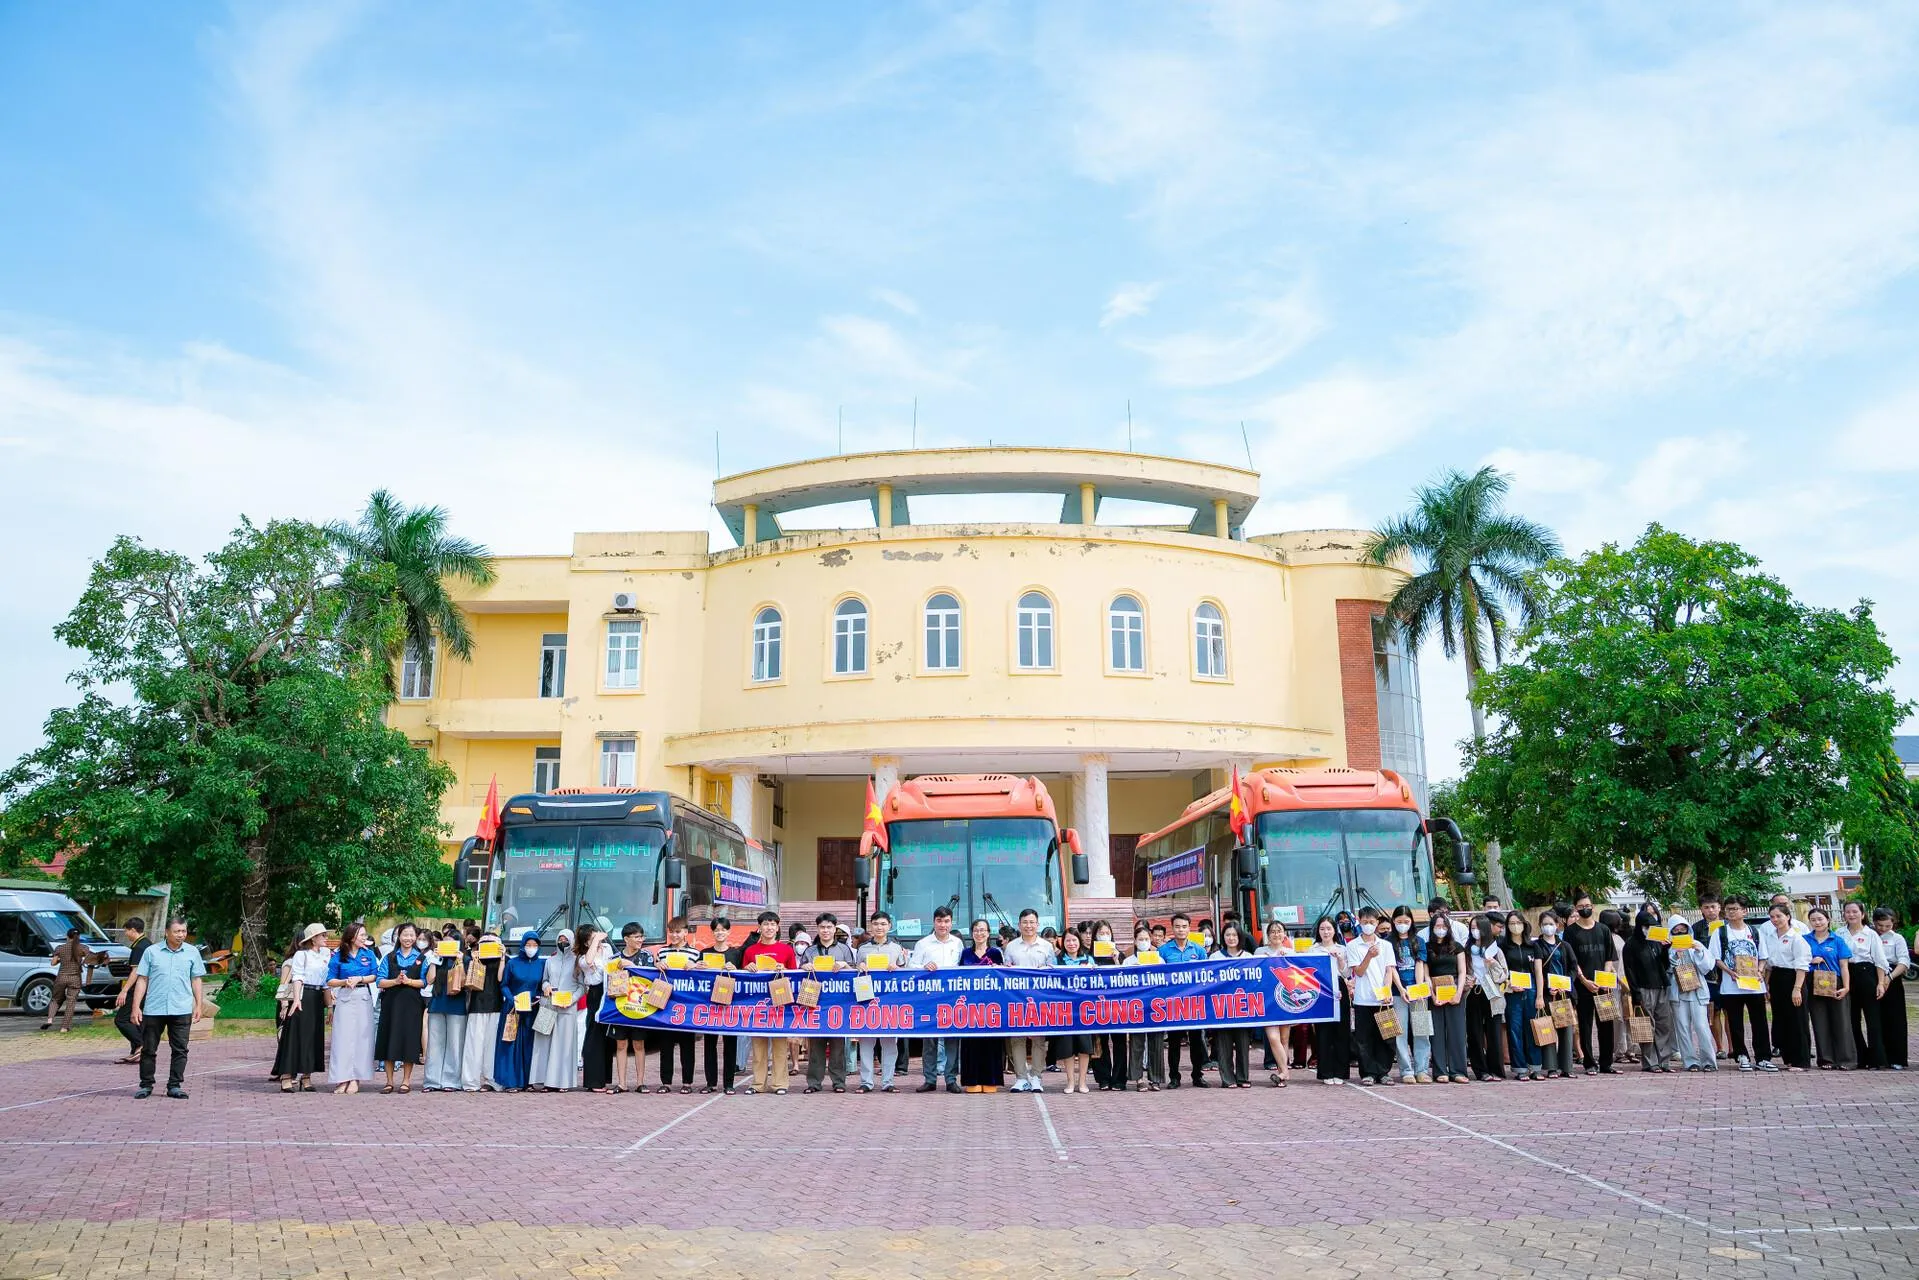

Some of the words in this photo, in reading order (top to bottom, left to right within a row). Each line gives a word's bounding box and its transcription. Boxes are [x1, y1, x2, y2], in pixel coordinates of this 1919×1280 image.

[673, 978, 694, 992] NHÀ
[698, 980, 711, 992] XE
[744, 981, 768, 995] TỊNH
[822, 978, 850, 993] CÙNG
[884, 977, 898, 992] XÃ
[918, 978, 945, 995] ĐẠM,
[948, 976, 971, 991] TIÊN
[1004, 976, 1029, 990] NGHI
[1032, 974, 1065, 991] XUÂN,
[1067, 974, 1087, 991] LỘC
[1090, 973, 1108, 990] HÀ,
[1141, 971, 1169, 987] LĨNH,
[1171, 971, 1192, 985] CAN
[1195, 967, 1218, 984] LỘC,
[1219, 966, 1241, 982] ĐỨC
[1243, 966, 1263, 983] THỌ
[671, 1004, 686, 1025] 3
[693, 998, 785, 1028] CHUYẾN
[791, 1004, 821, 1029] XE
[920, 1014, 931, 1022] -
[1008, 996, 1074, 1027] HÀNH
[1080, 994, 1145, 1026] CÙNG
[1150, 994, 1206, 1023] SINH
[1211, 988, 1265, 1019] VIÊN
